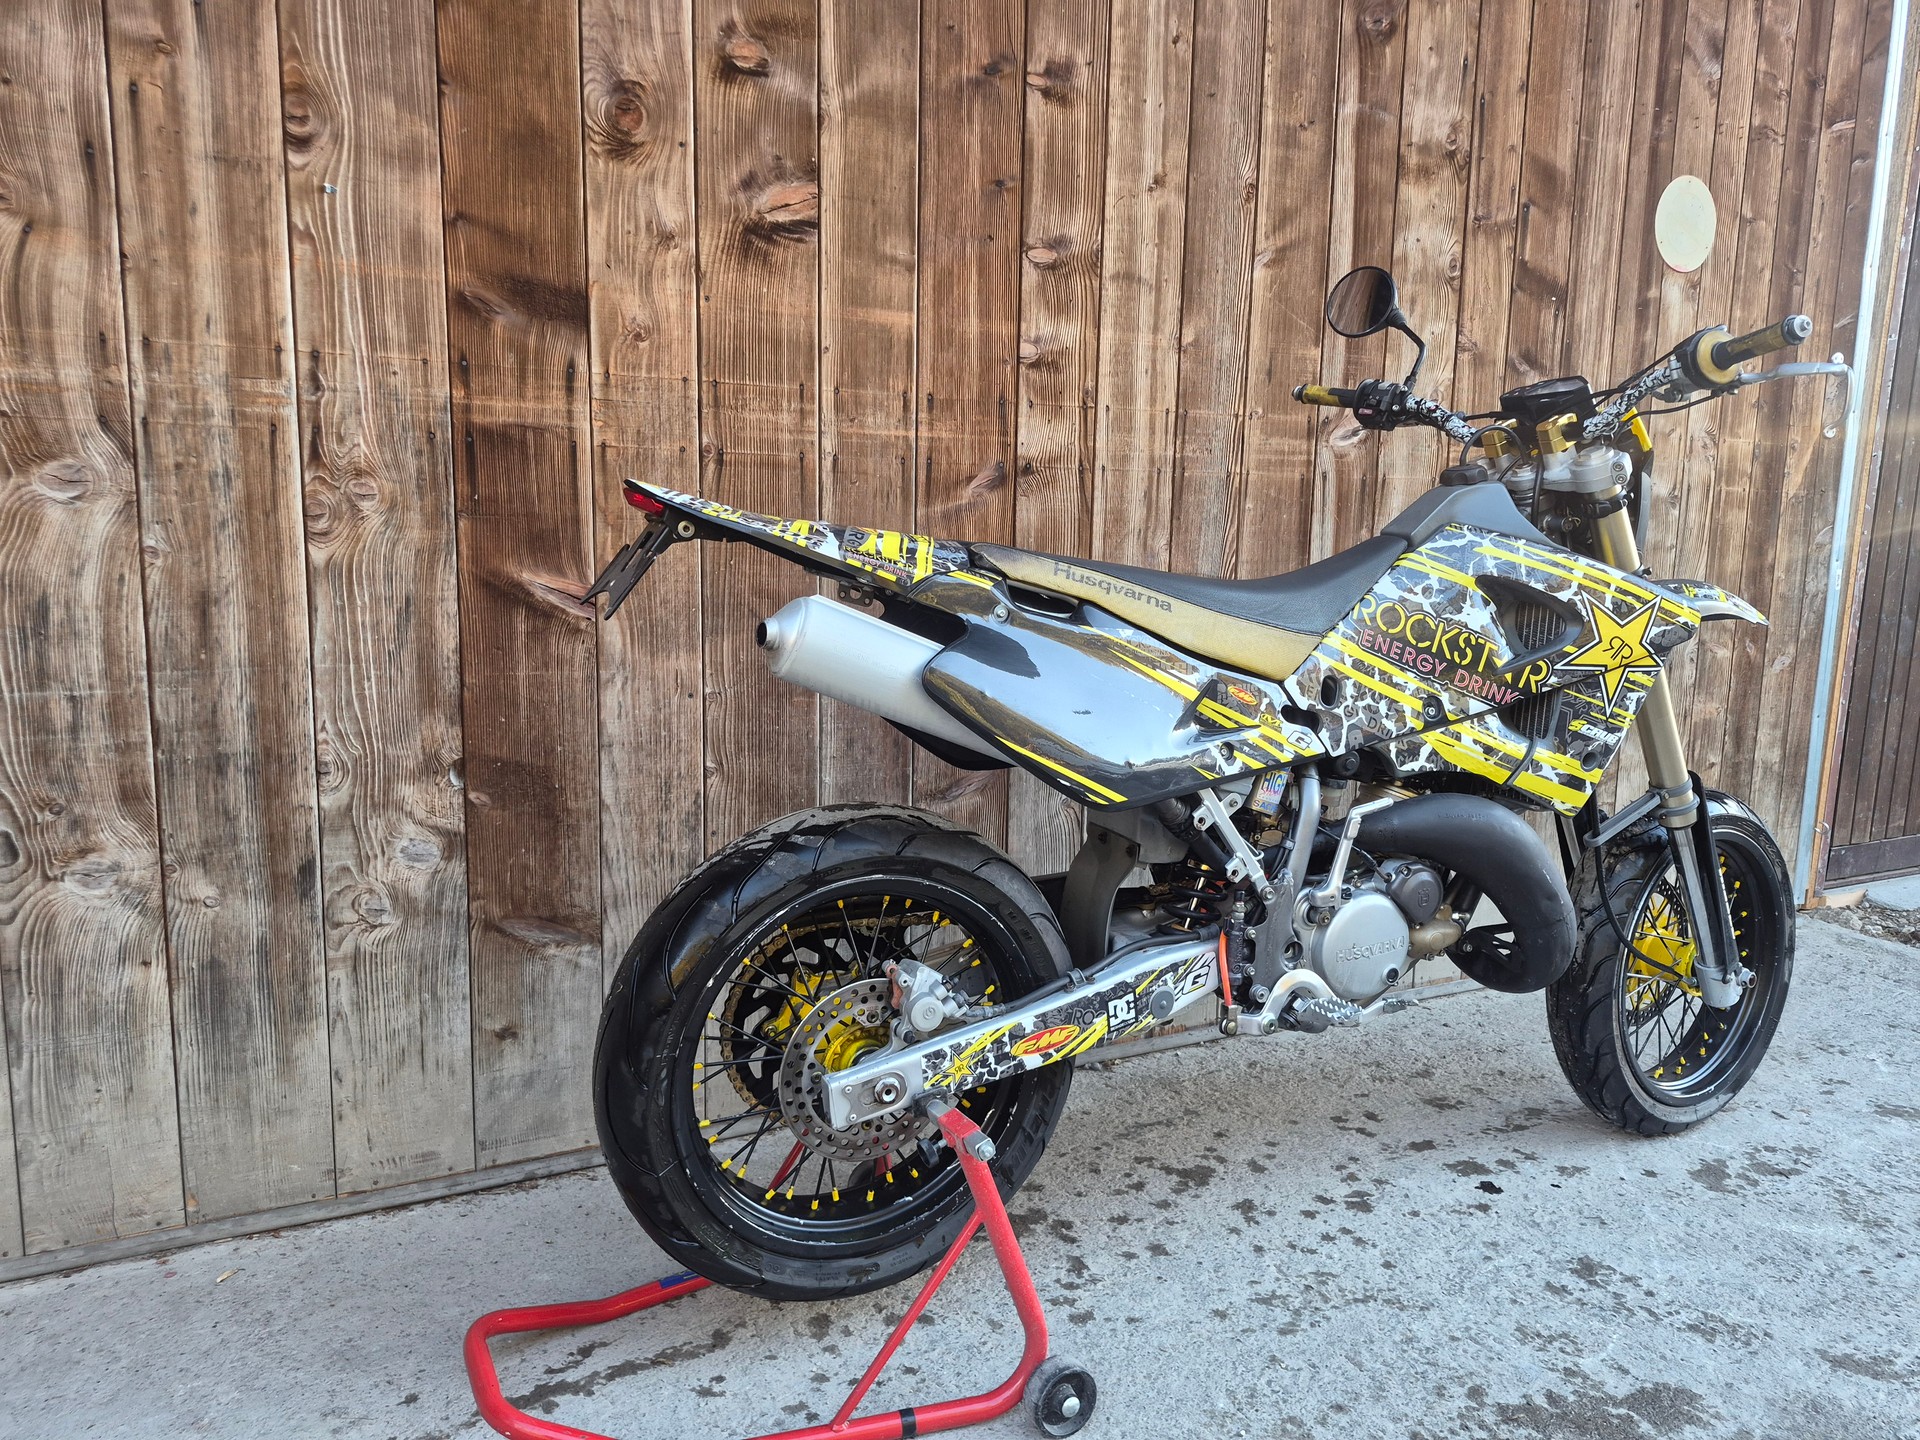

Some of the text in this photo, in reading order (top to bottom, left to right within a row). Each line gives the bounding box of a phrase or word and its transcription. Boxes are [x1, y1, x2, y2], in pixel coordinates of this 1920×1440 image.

[883, 564, 909, 578] DRINK
[1053, 561, 1173, 613] Husqvarna
[1353, 594, 1548, 693] ROCKSTR
[1361, 629, 1520, 705] ENERGY DRINK
[1336, 936, 1405, 962] HUSQVARNA
[1108, 992, 1136, 1026] DC
[1014, 1028, 1078, 1055] FMF
